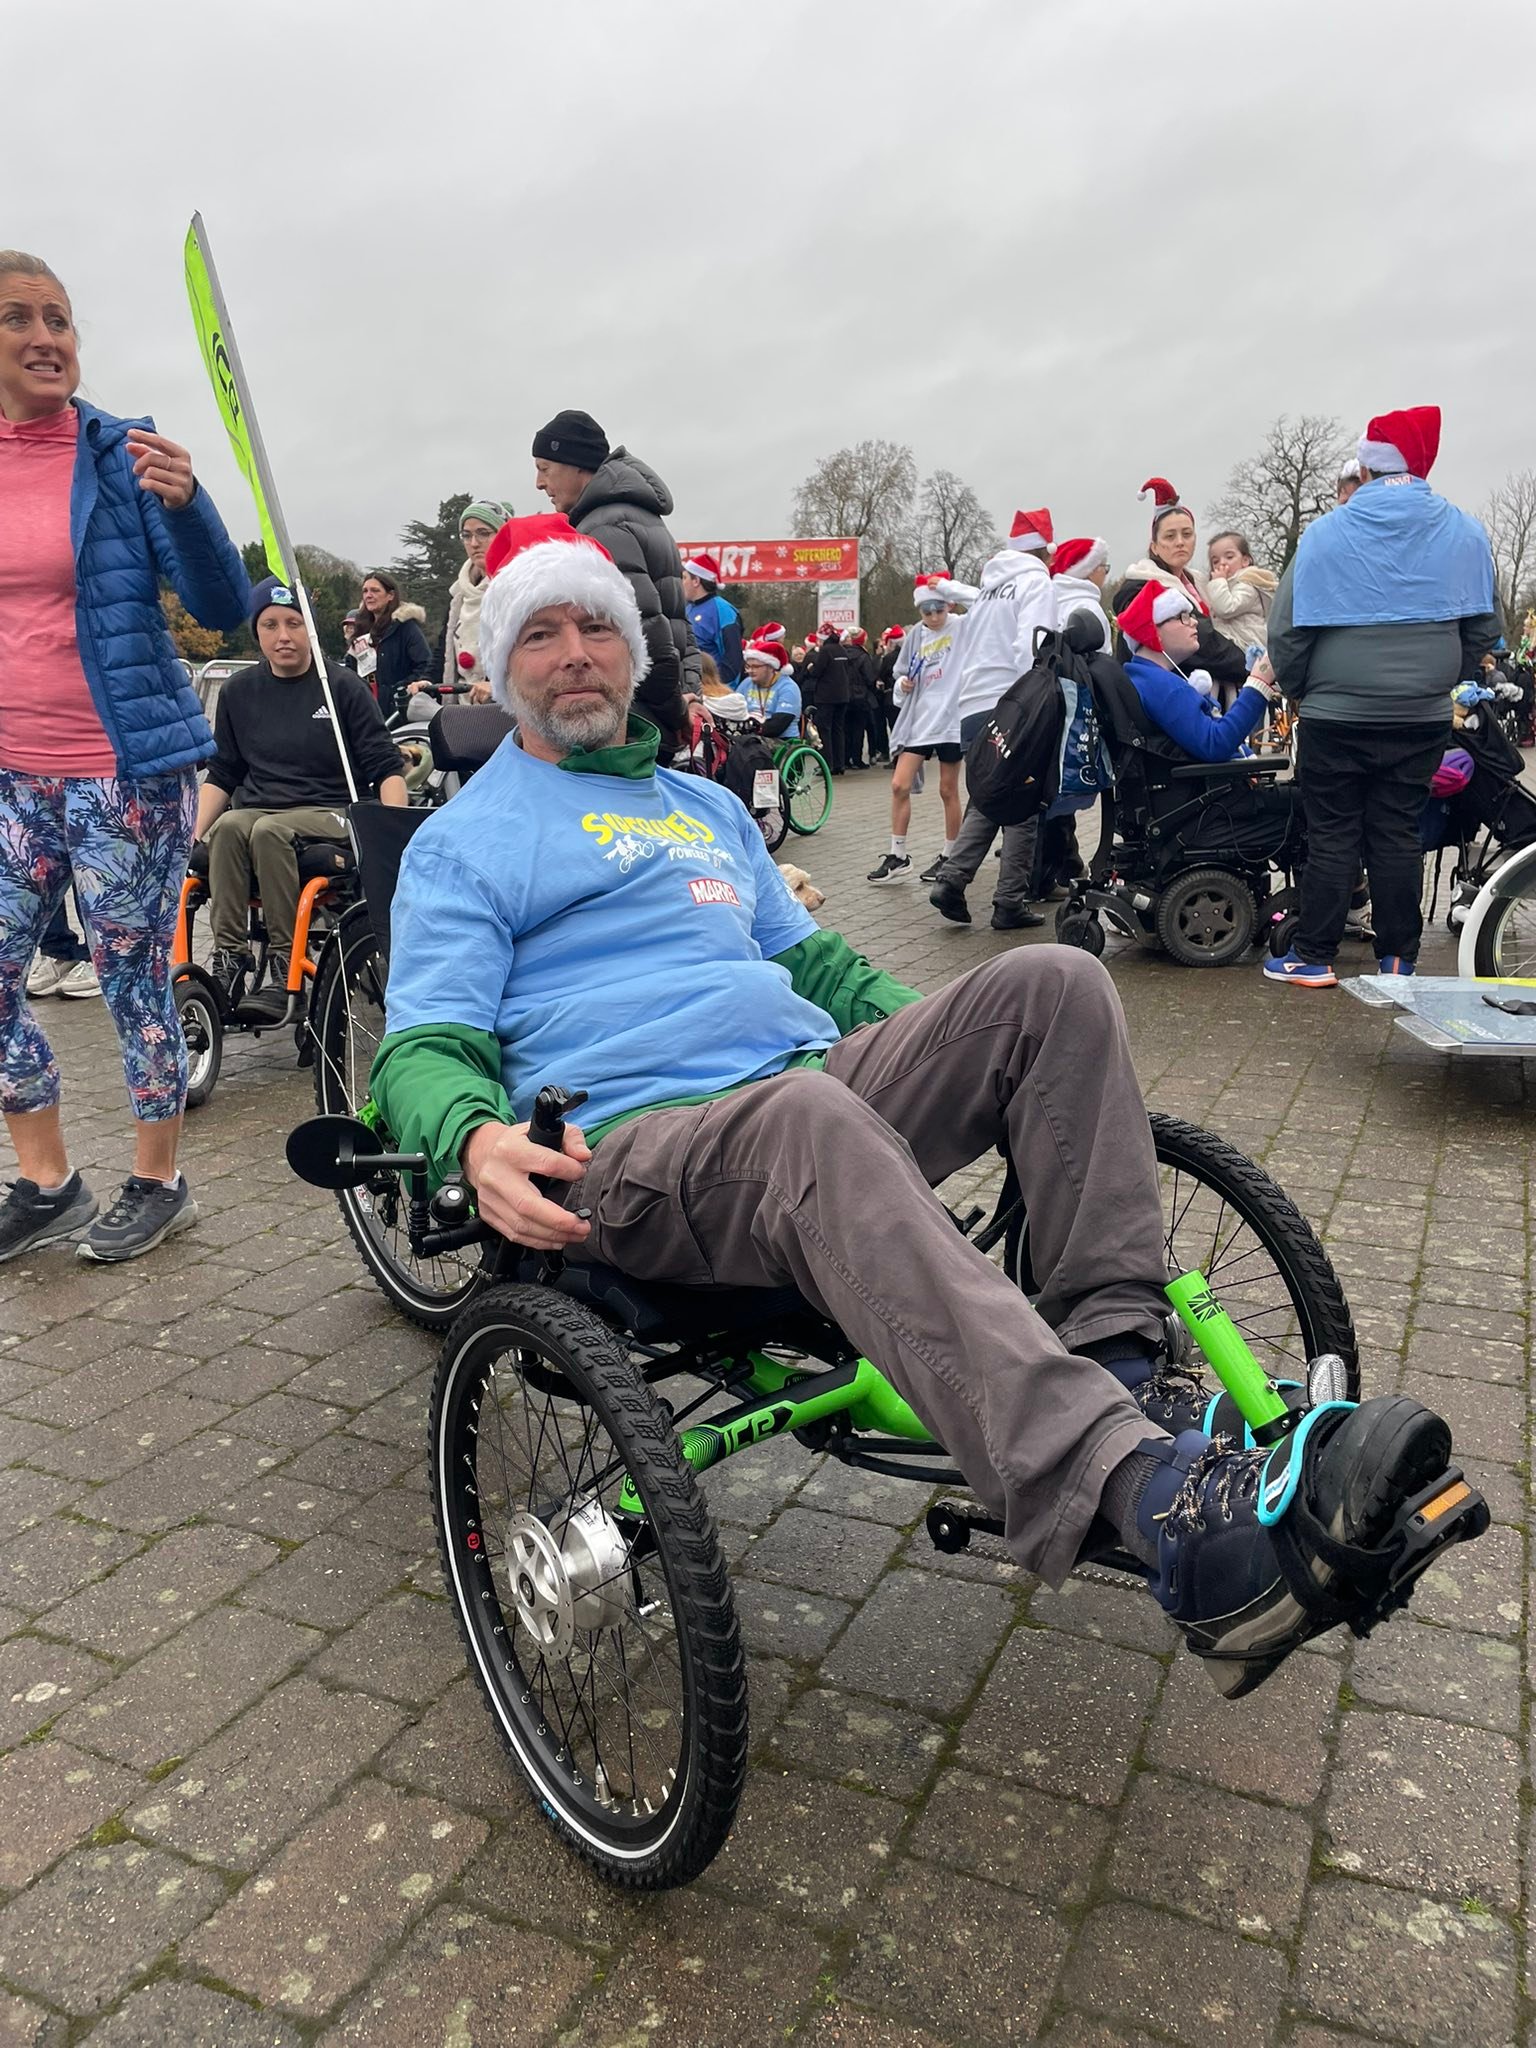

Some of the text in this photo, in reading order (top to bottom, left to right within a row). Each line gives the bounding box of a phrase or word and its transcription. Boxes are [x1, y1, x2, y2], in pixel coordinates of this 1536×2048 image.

[793, 547, 842, 562] SUPERHERO
[823, 610, 854, 622] MARVEL
[668, 846, 710, 862] POWERED
[712, 855, 722, 869] BY
